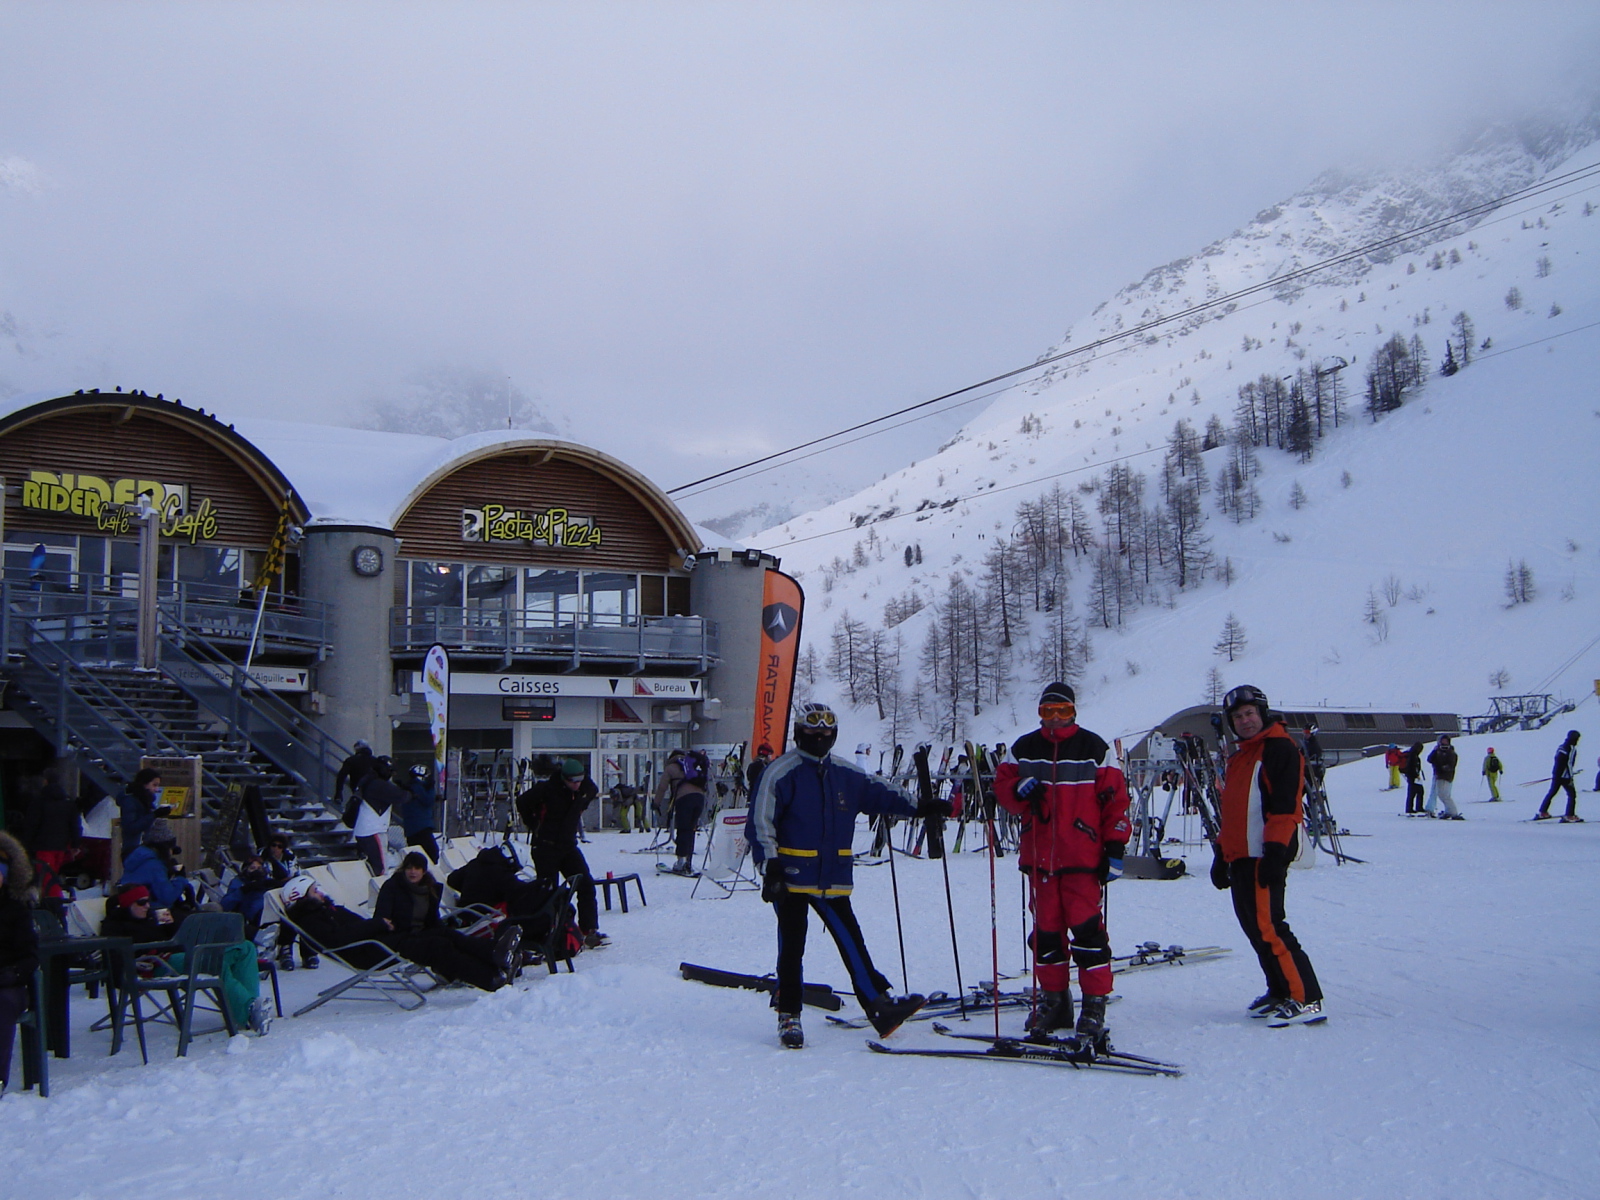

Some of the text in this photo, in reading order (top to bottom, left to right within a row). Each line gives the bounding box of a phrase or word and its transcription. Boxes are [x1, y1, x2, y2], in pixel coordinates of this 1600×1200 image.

[22, 480, 130, 536] RIDER Café
[498, 677, 560, 694] Caisses
[654, 682, 686, 693] Bureau
